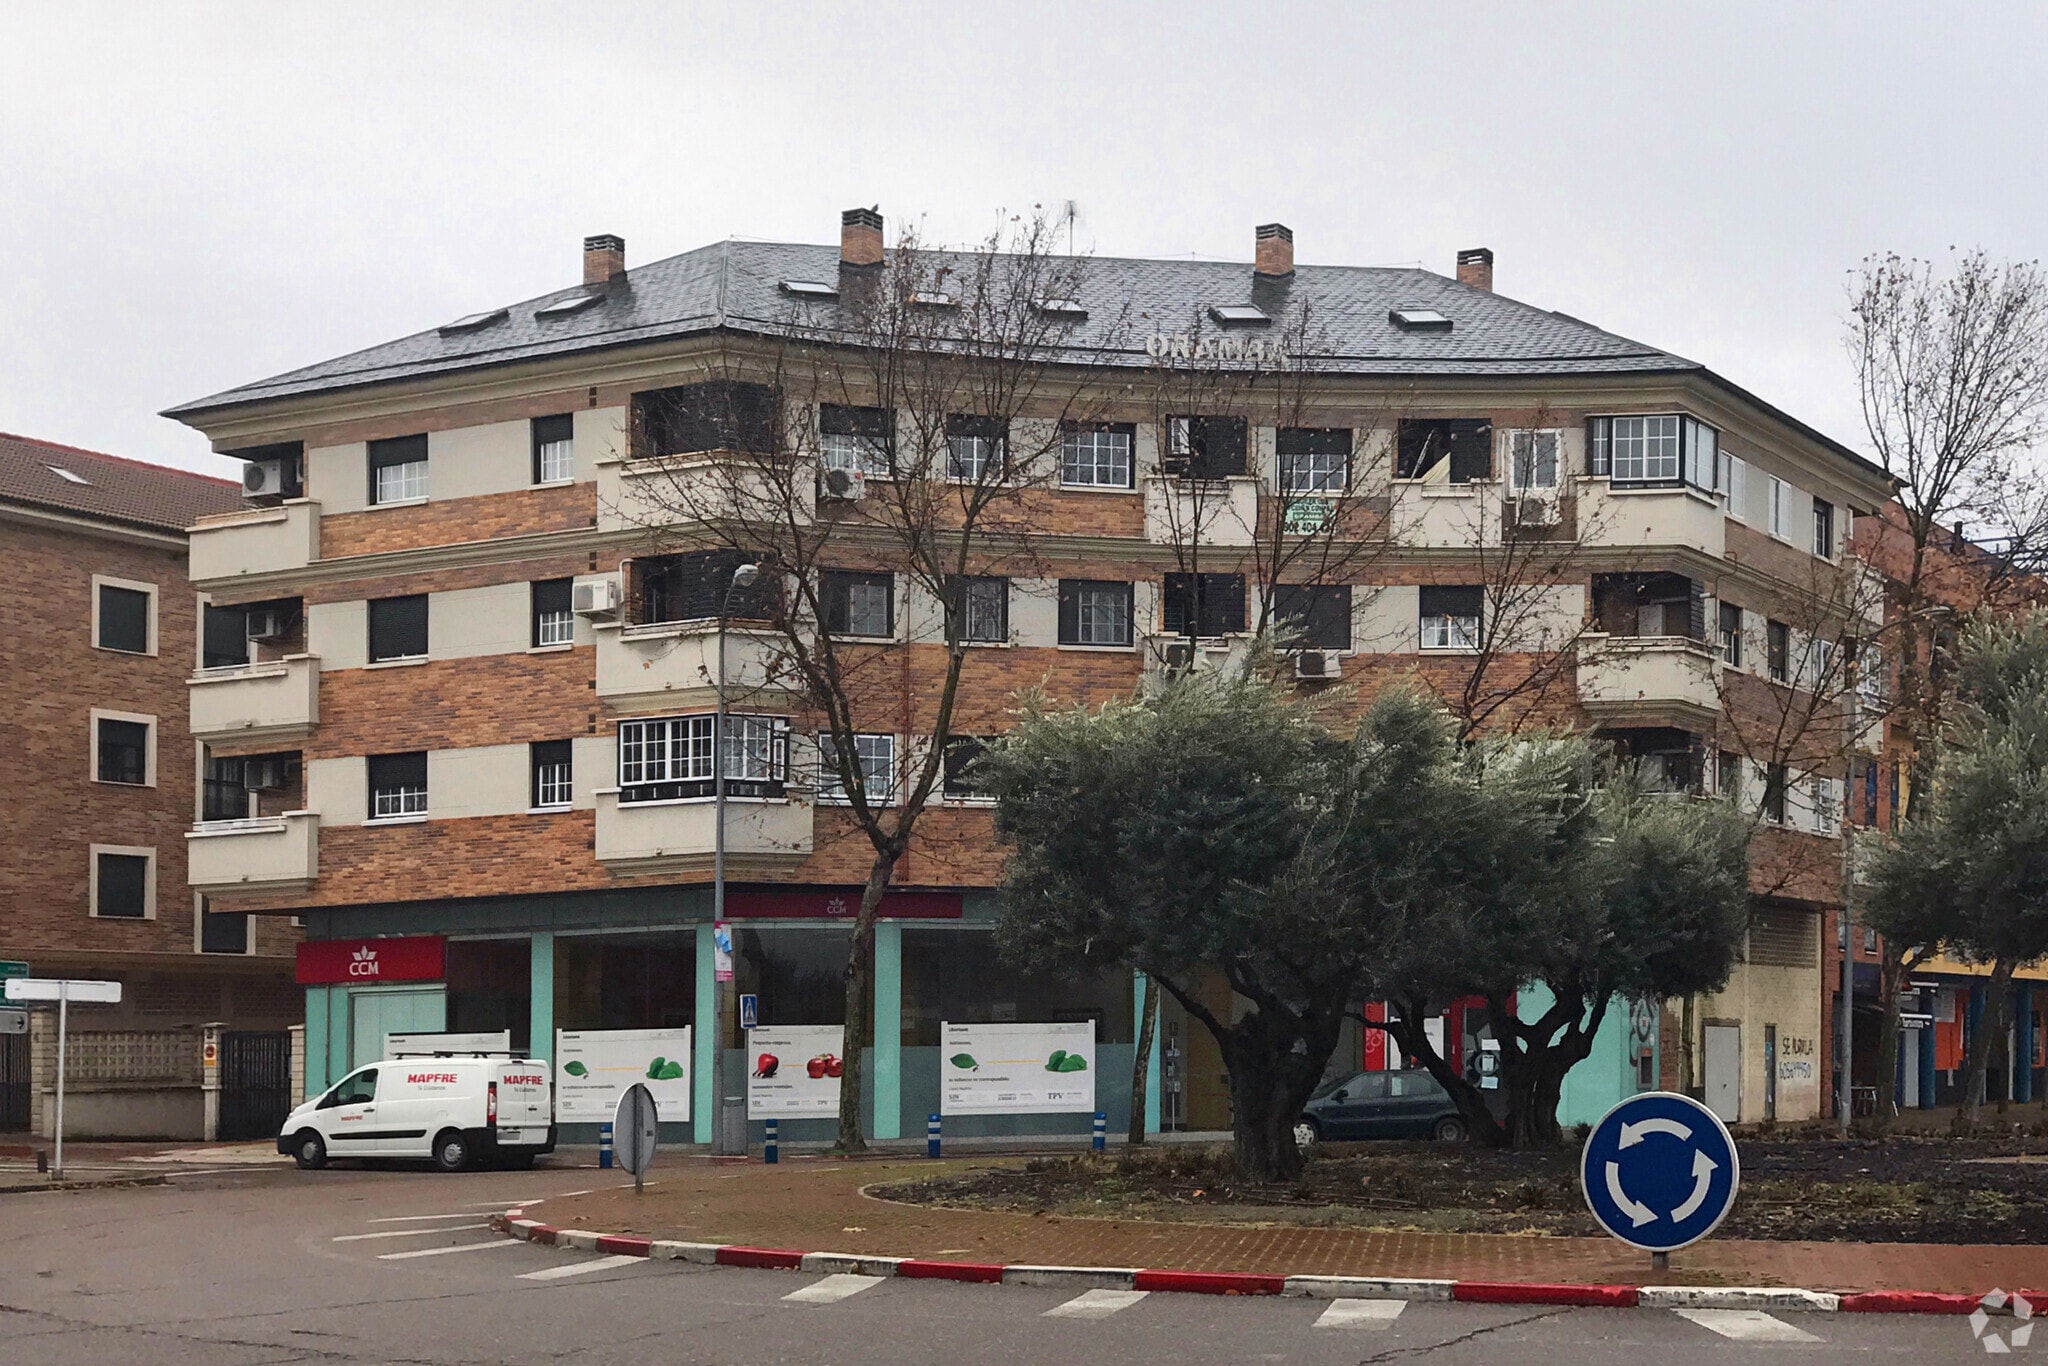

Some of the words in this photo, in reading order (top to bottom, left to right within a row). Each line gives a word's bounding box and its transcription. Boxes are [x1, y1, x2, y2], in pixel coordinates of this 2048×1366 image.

[827, 905, 847, 914] CCM
[349, 961, 379, 976] CCM
[1782, 1037, 1790, 1056] SE
[407, 1073, 458, 1084] MAPFRE
[503, 1075, 543, 1086] MAPFRE
[1048, 1092, 1065, 1100] TPV
